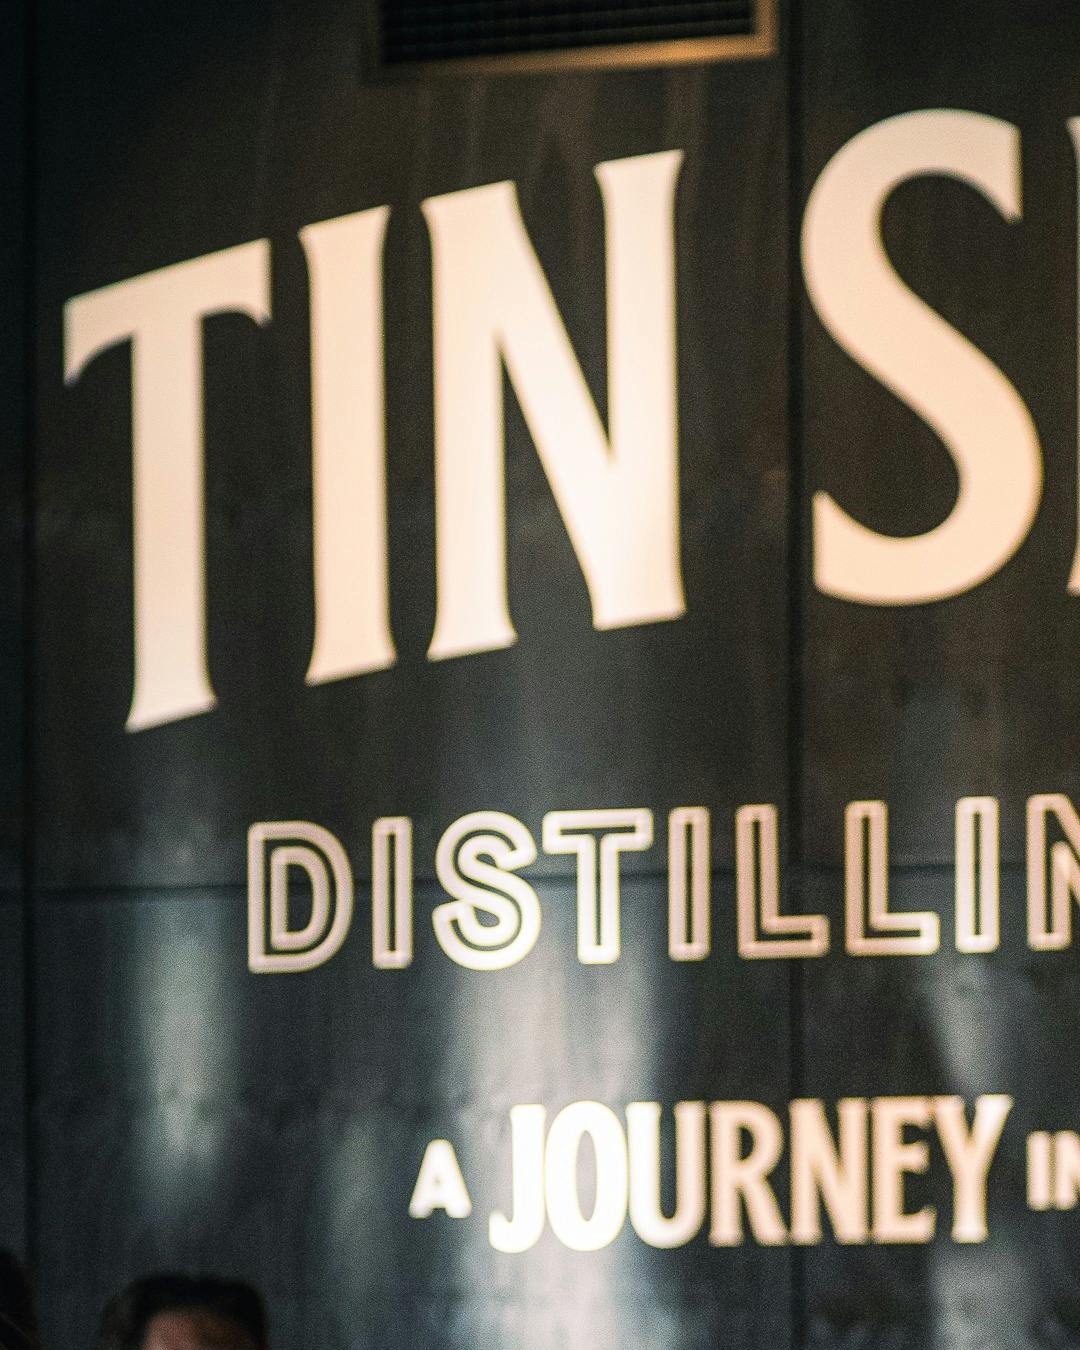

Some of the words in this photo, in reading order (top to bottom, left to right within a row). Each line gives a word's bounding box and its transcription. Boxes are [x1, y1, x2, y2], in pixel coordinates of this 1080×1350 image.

[64, 149, 687, 732] TIN
[407, 1139, 473, 1219] A
[489, 1093, 1013, 1254] JOURNEY
